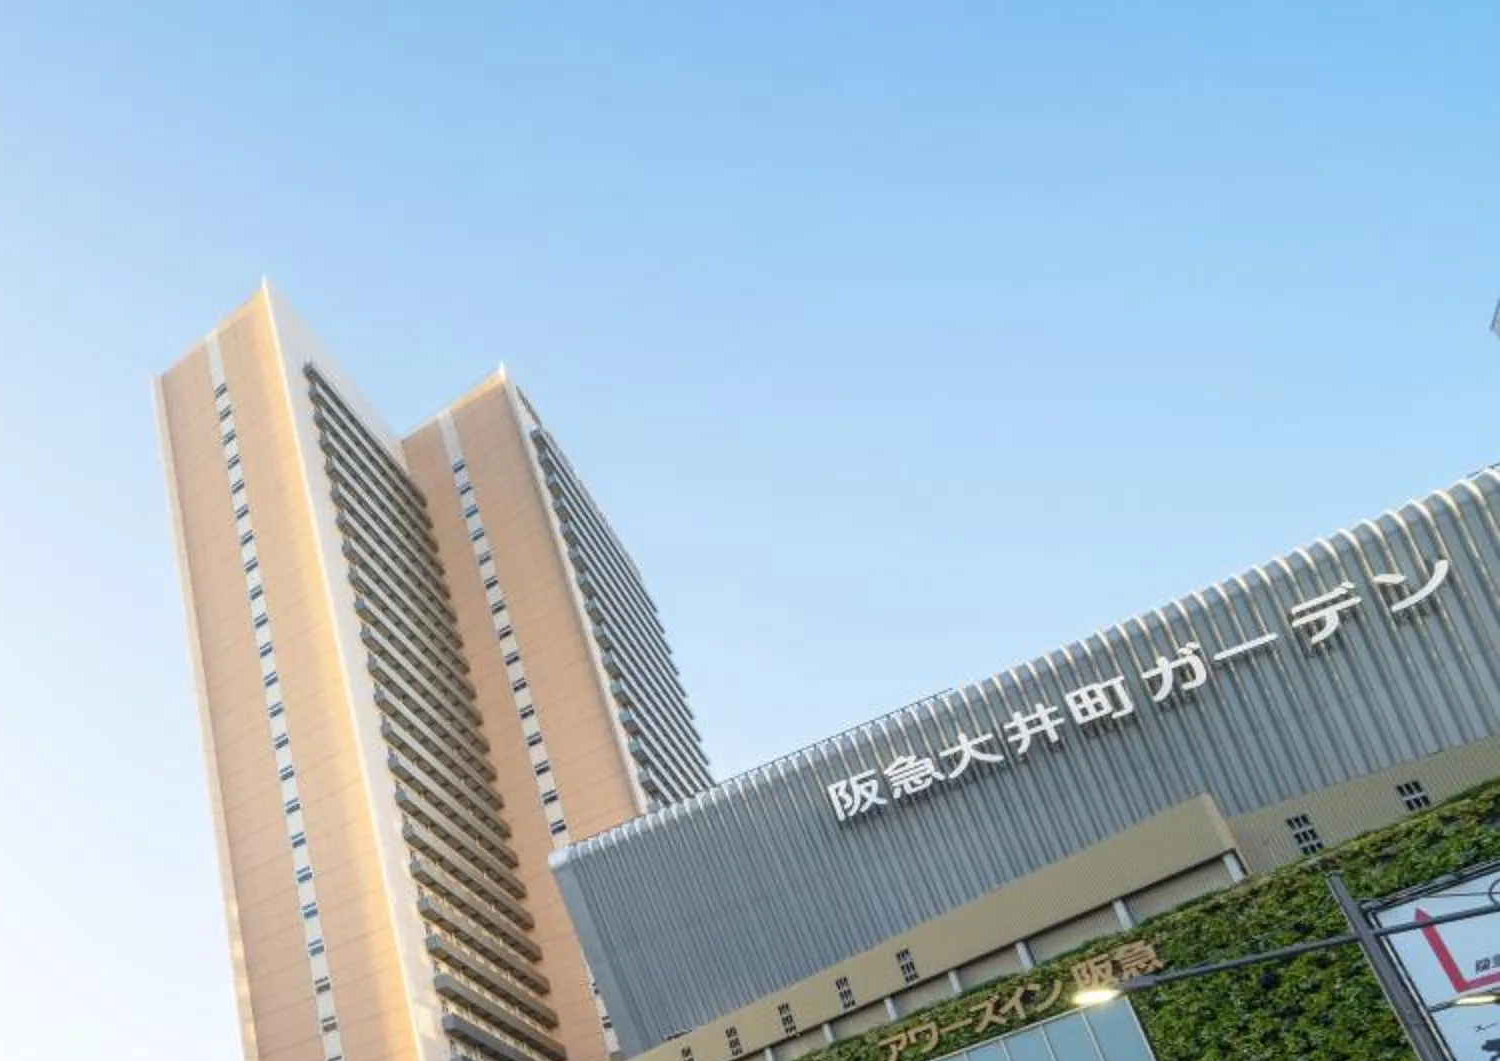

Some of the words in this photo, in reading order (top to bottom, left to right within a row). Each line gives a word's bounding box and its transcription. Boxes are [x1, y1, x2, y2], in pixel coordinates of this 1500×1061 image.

[827, 558, 1450, 822] 阪急大井町ガーデン
